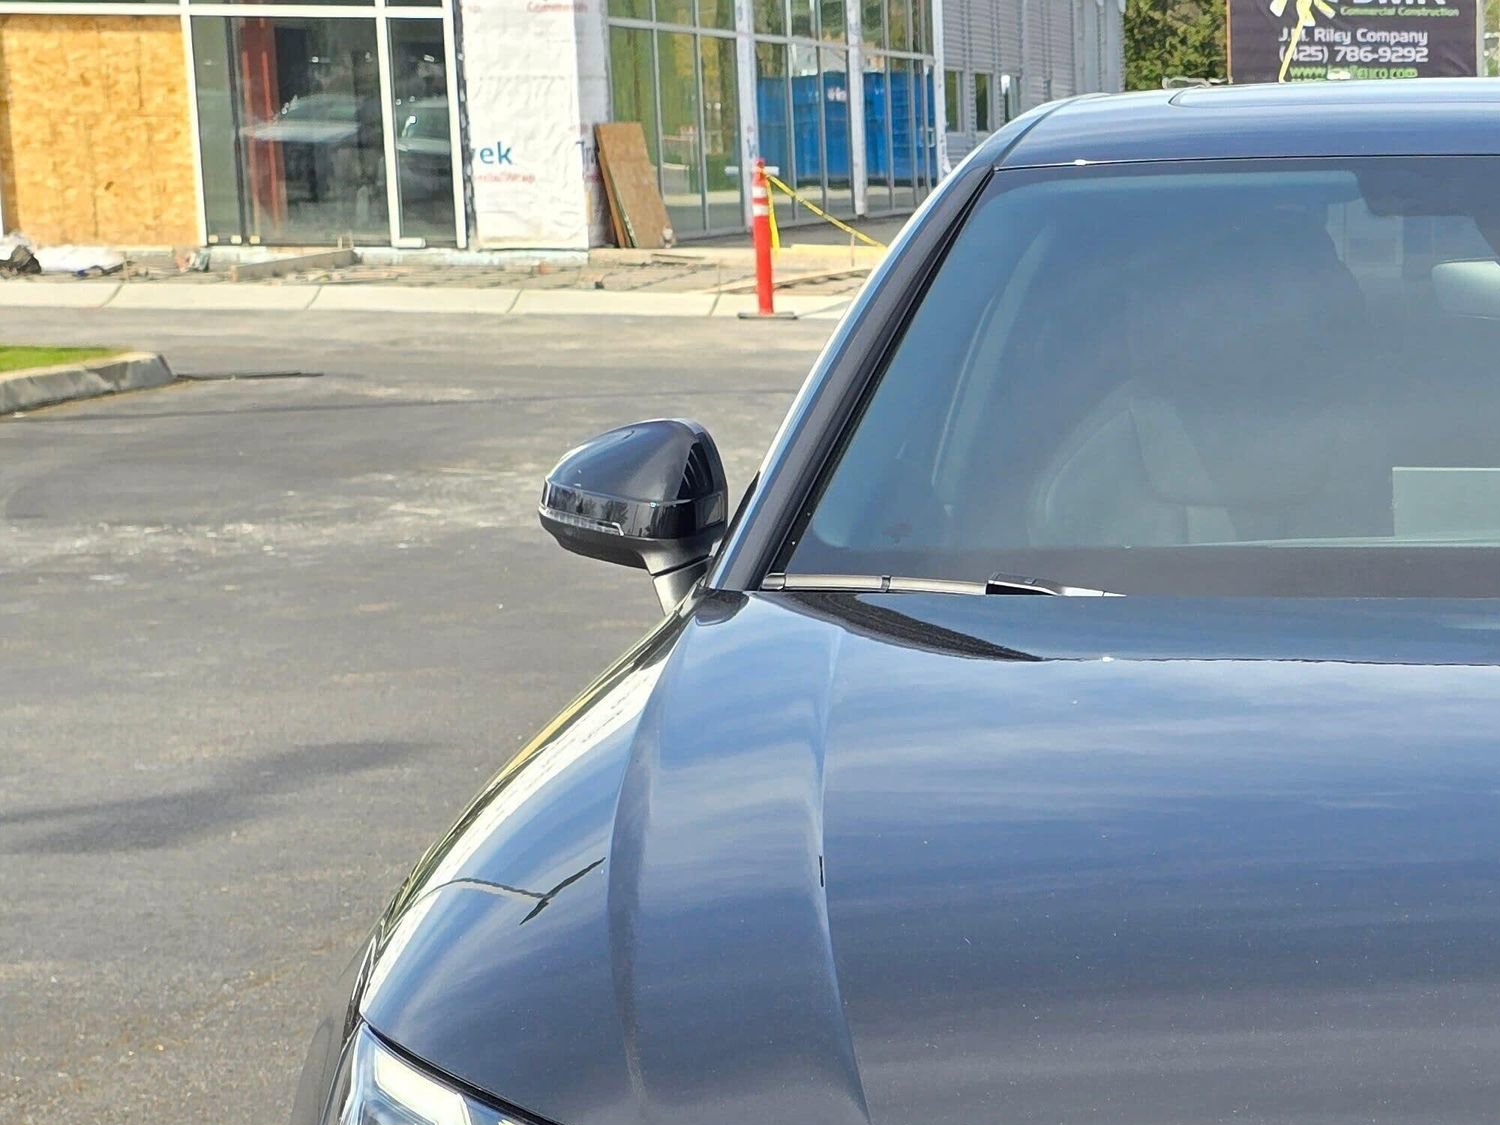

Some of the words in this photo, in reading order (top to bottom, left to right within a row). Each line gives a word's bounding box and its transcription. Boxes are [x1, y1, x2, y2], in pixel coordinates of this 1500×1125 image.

[1340, 6, 1396, 16] Commercial
[1398, 7, 1460, 17] Construction
[1314, 28, 1351, 45] Riley
[1356, 28, 1428, 46] Company
[1335, 47, 1429, 63] 786-9292
